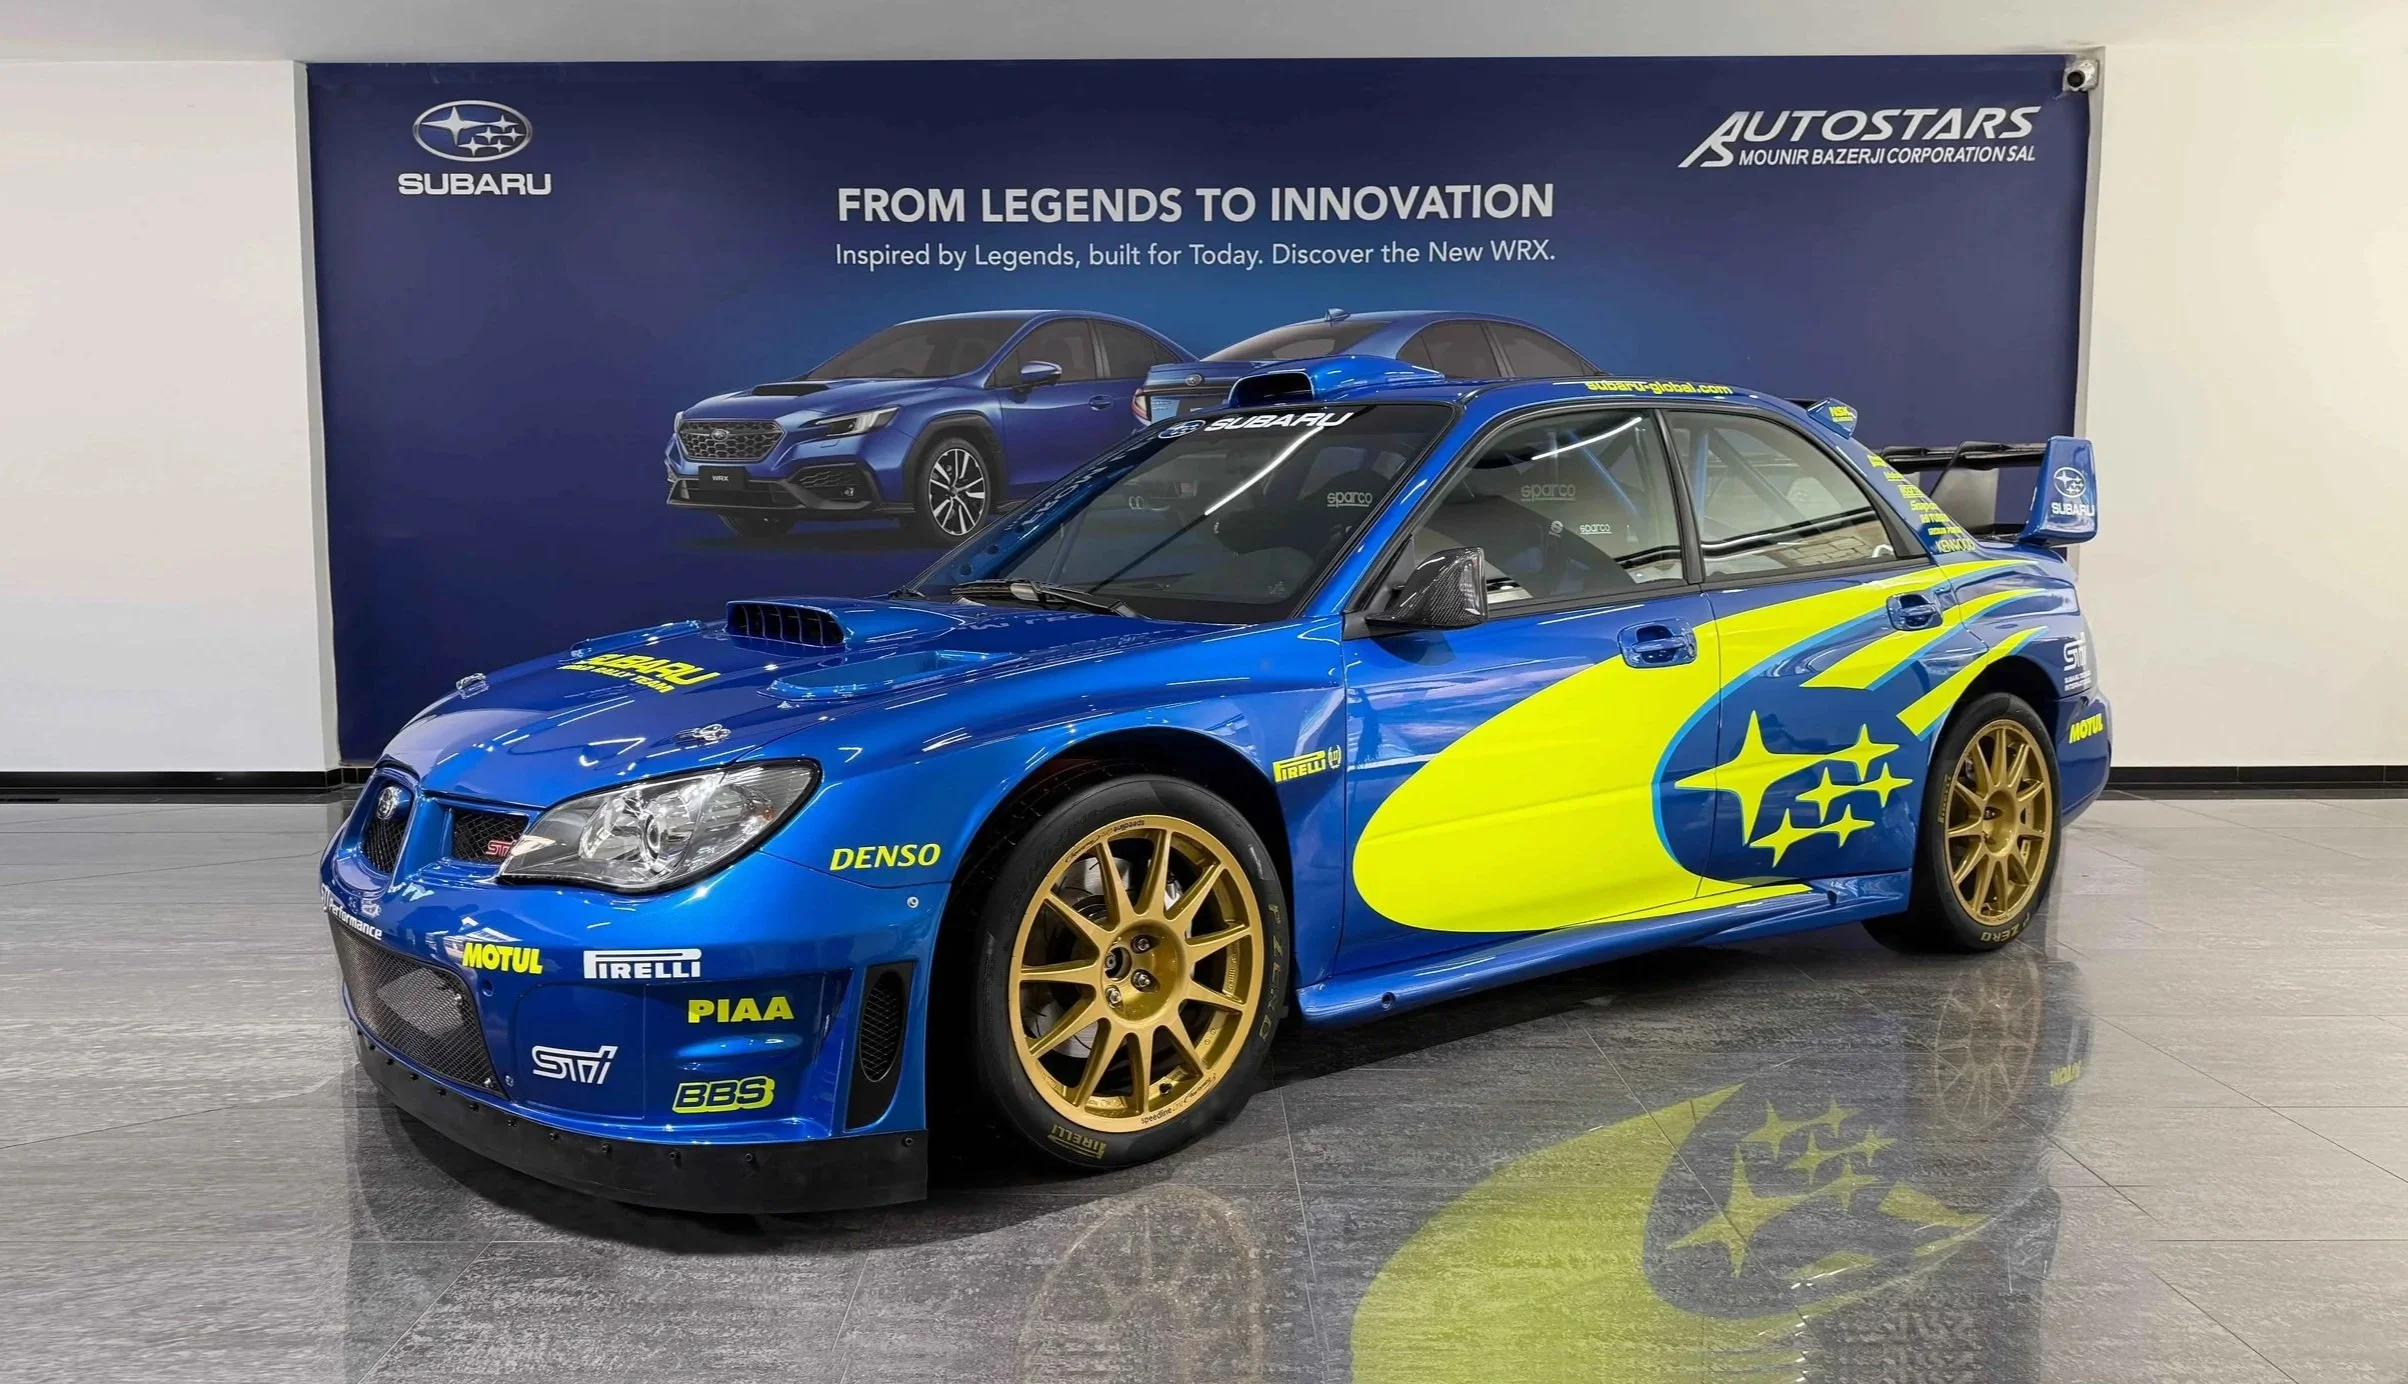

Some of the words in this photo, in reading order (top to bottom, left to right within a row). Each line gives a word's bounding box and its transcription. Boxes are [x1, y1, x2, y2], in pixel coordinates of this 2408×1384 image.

[1738, 148, 1809, 166] MOUNIR
[1811, 147, 1884, 165] BAZERJI
[1886, 146, 2003, 164] CORPORATION
[2008, 144, 2036, 162] SAL
[398, 173, 552, 196] SUBARU
[838, 187, 966, 223] FROM
[982, 187, 1182, 223] LEGENDS
[1196, 187, 1256, 222] TO
[1271, 183, 1554, 221] INNOVATION
[835, 243, 931, 272] Inspired
[938, 243, 967, 271] by
[975, 243, 1080, 271] Legends,
[1089, 243, 1142, 266] built
[1147, 243, 1182, 265] for
[1188, 243, 1264, 271] Today.
[1272, 243, 1374, 265] Discover
[1380, 241, 1421, 264] the
[1428, 241, 1484, 263] New
[1490, 239, 1556, 262] WRX.
[1204, 412, 1354, 432] SUBARU
[1327, 490, 1373, 507] sparco
[1521, 484, 1576, 501] sparco
[2051, 502, 2095, 517] SUBARU
[1579, 523, 1612, 534] sparco
[629, 675, 676, 694] TEAM
[2068, 713, 2104, 744] MOTUL
[1272, 750, 1326, 783] PIRELLI
[829, 843, 941, 871] DENSO
[1980, 922, 2020, 943] ZERO
[462, 942, 543, 975] MOTUL
[583, 948, 702, 979] PIRELLI
[688, 996, 795, 1024] PIAA
[672, 1076, 776, 1113] BBS
[1047, 1124, 1107, 1159] PIRELLI
